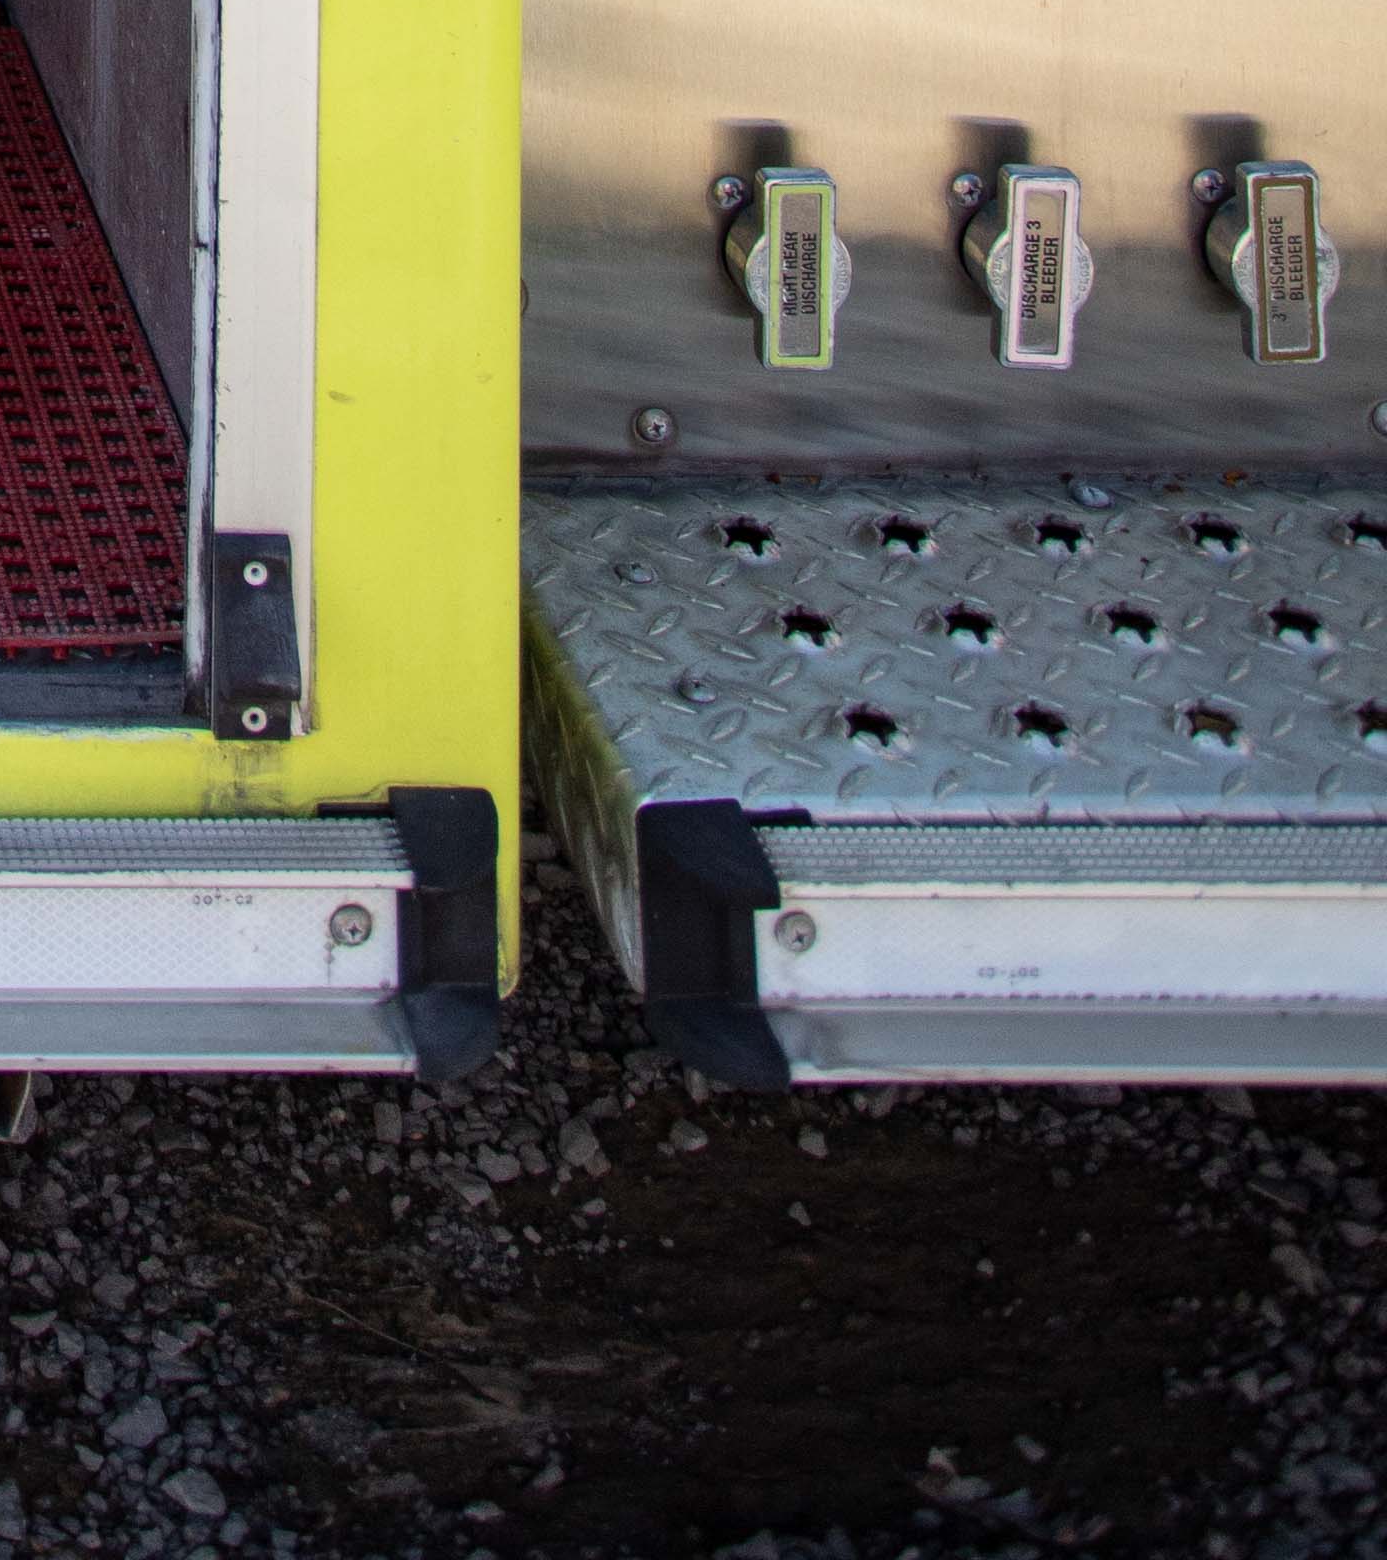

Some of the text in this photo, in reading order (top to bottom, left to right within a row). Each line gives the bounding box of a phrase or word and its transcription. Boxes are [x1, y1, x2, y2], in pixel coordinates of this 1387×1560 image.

[783, 231, 798, 316] RIGHT REAR
[801, 232, 817, 315] DISCHARGE
[1022, 220, 1041, 319] DISCHARGE 3
[1041, 237, 1059, 304] BLEEDER
[1268, 216, 1285, 301] DISCHARGE
[1288, 235, 1304, 301] BLEEDER
